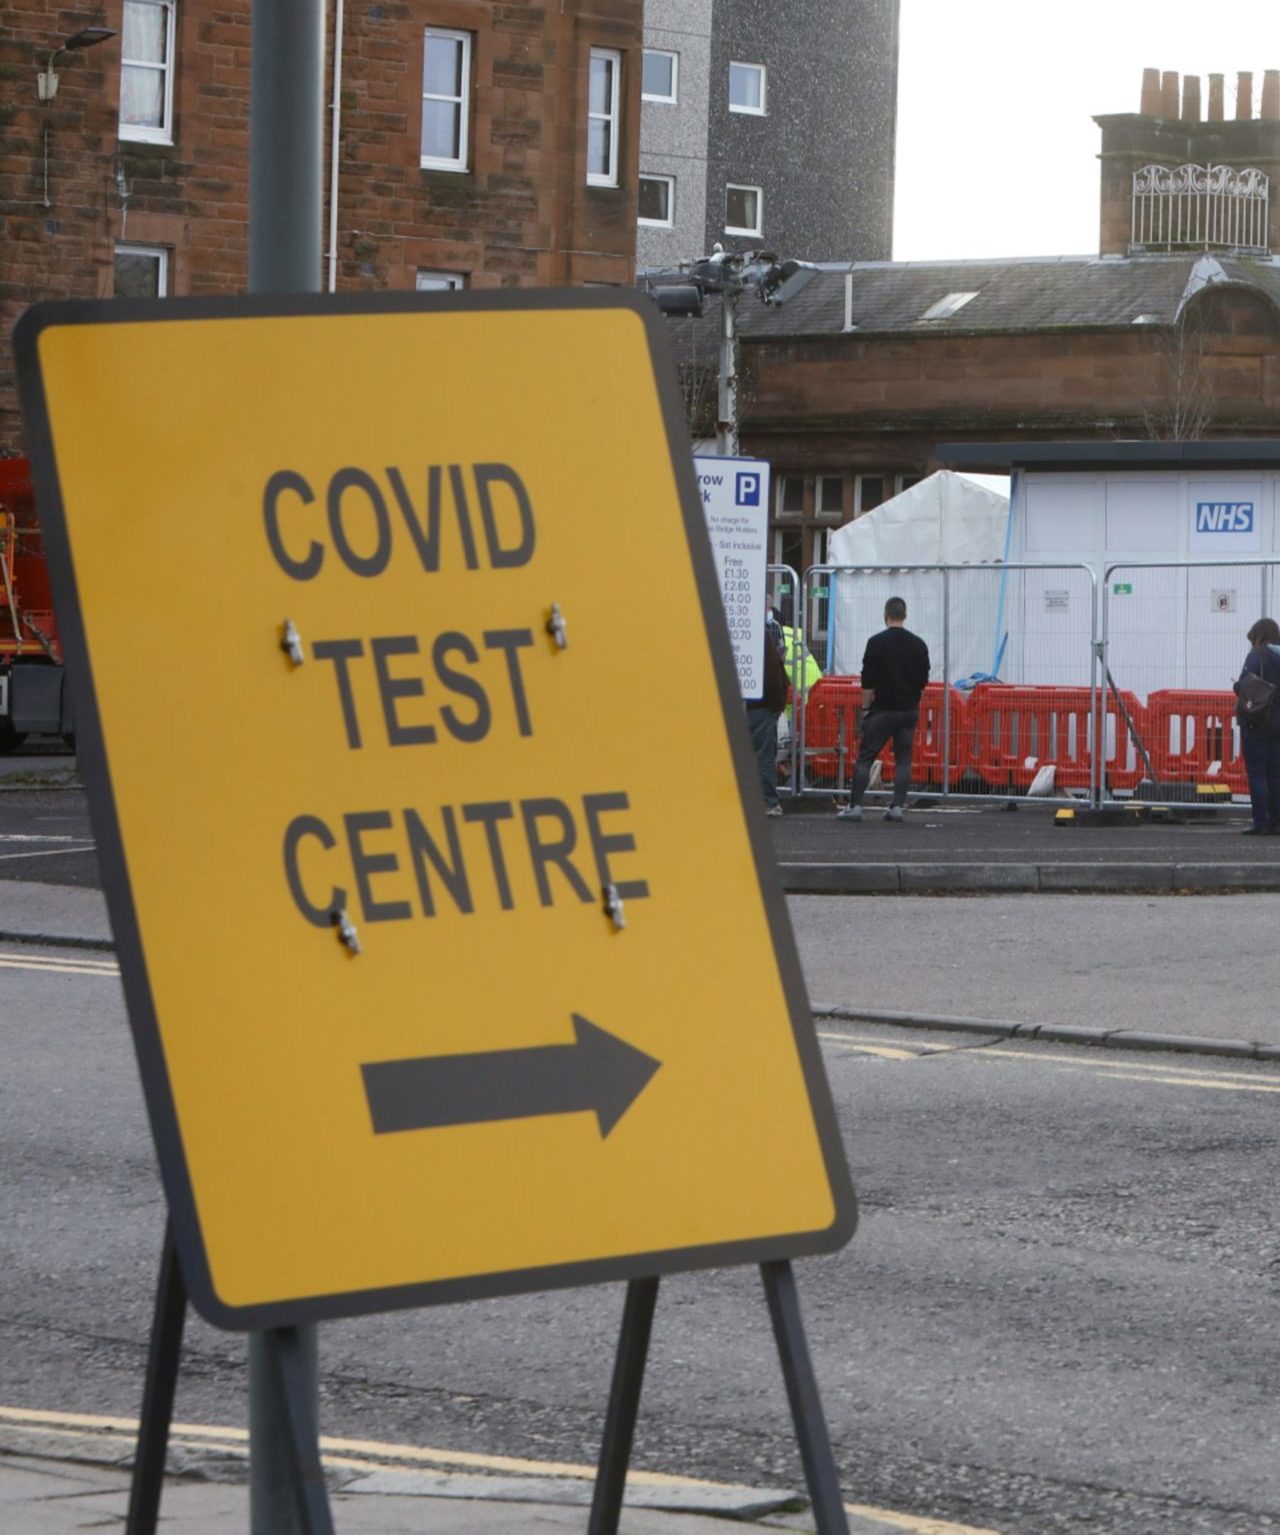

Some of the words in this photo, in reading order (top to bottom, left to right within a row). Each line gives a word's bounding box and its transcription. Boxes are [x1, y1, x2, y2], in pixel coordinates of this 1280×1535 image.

[698, 475, 723, 486] row
[740, 476, 756, 503] P
[263, 463, 536, 581] COVID
[1198, 504, 1252, 530] NHS
[733, 541, 762, 551] inclusive
[725, 555, 743, 567] Free
[724, 568, 749, 580] £1.30
[729, 617, 751, 629] 8.00
[312, 628, 535, 750] TEST
[283, 792, 650, 929] CENTRE
